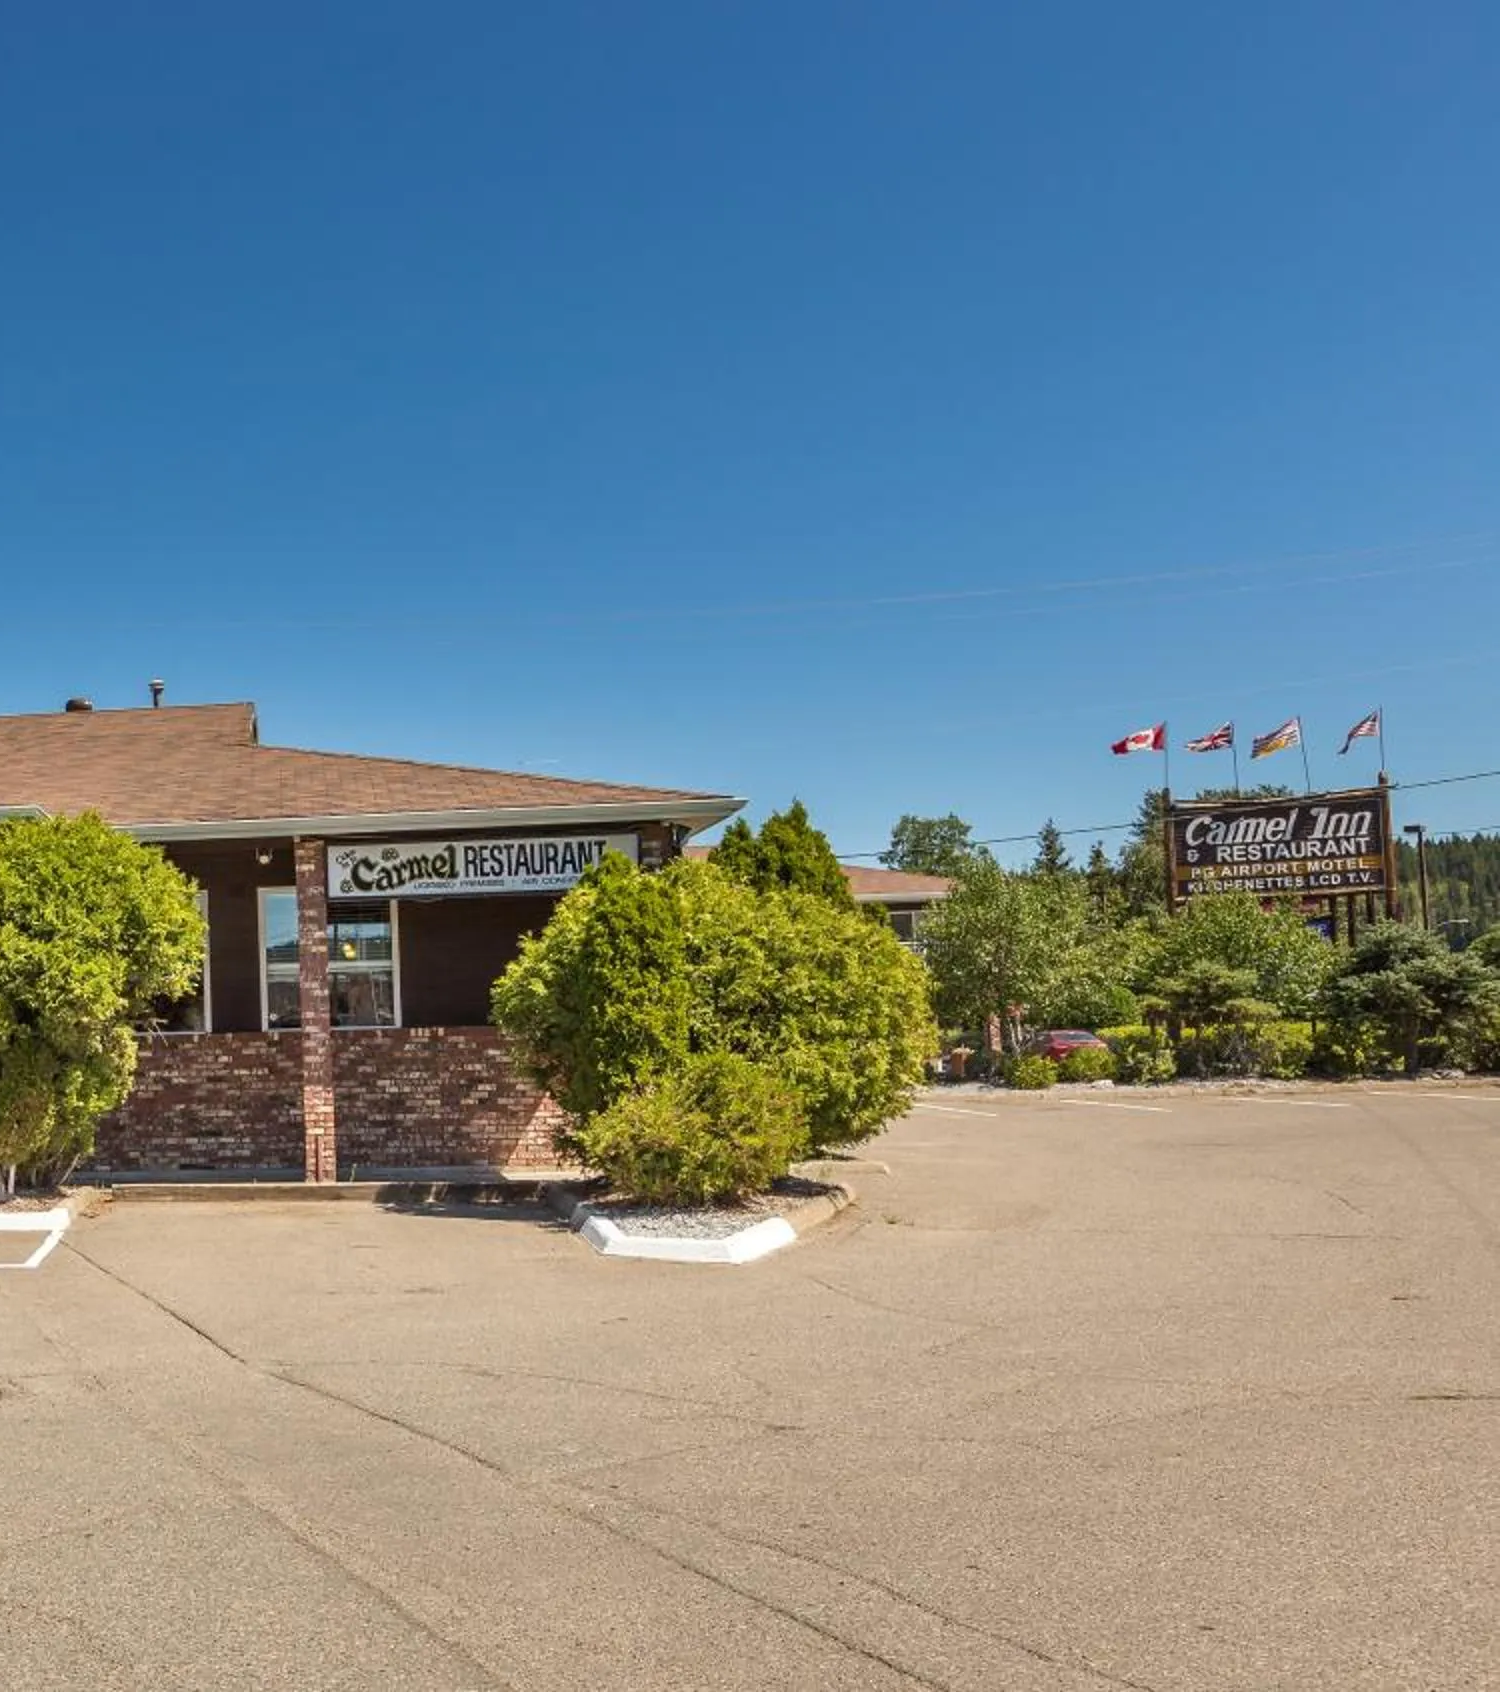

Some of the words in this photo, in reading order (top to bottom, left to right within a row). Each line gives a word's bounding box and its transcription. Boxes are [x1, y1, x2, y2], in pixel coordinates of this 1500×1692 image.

[1185, 807, 1299, 847] Carmel
[1308, 807, 1372, 839] Inn
[1187, 849, 1200, 863] &
[1216, 838, 1370, 863] RESTAURANT
[351, 843, 460, 892] Carmel
[464, 840, 606, 877] RESTAURANT
[1191, 867, 1215, 879] PG
[1221, 861, 1304, 877] AIRPORT
[1307, 856, 1369, 872] MOTEL
[1309, 872, 1341, 887] LCD
[1347, 871, 1374, 884] T.V.
